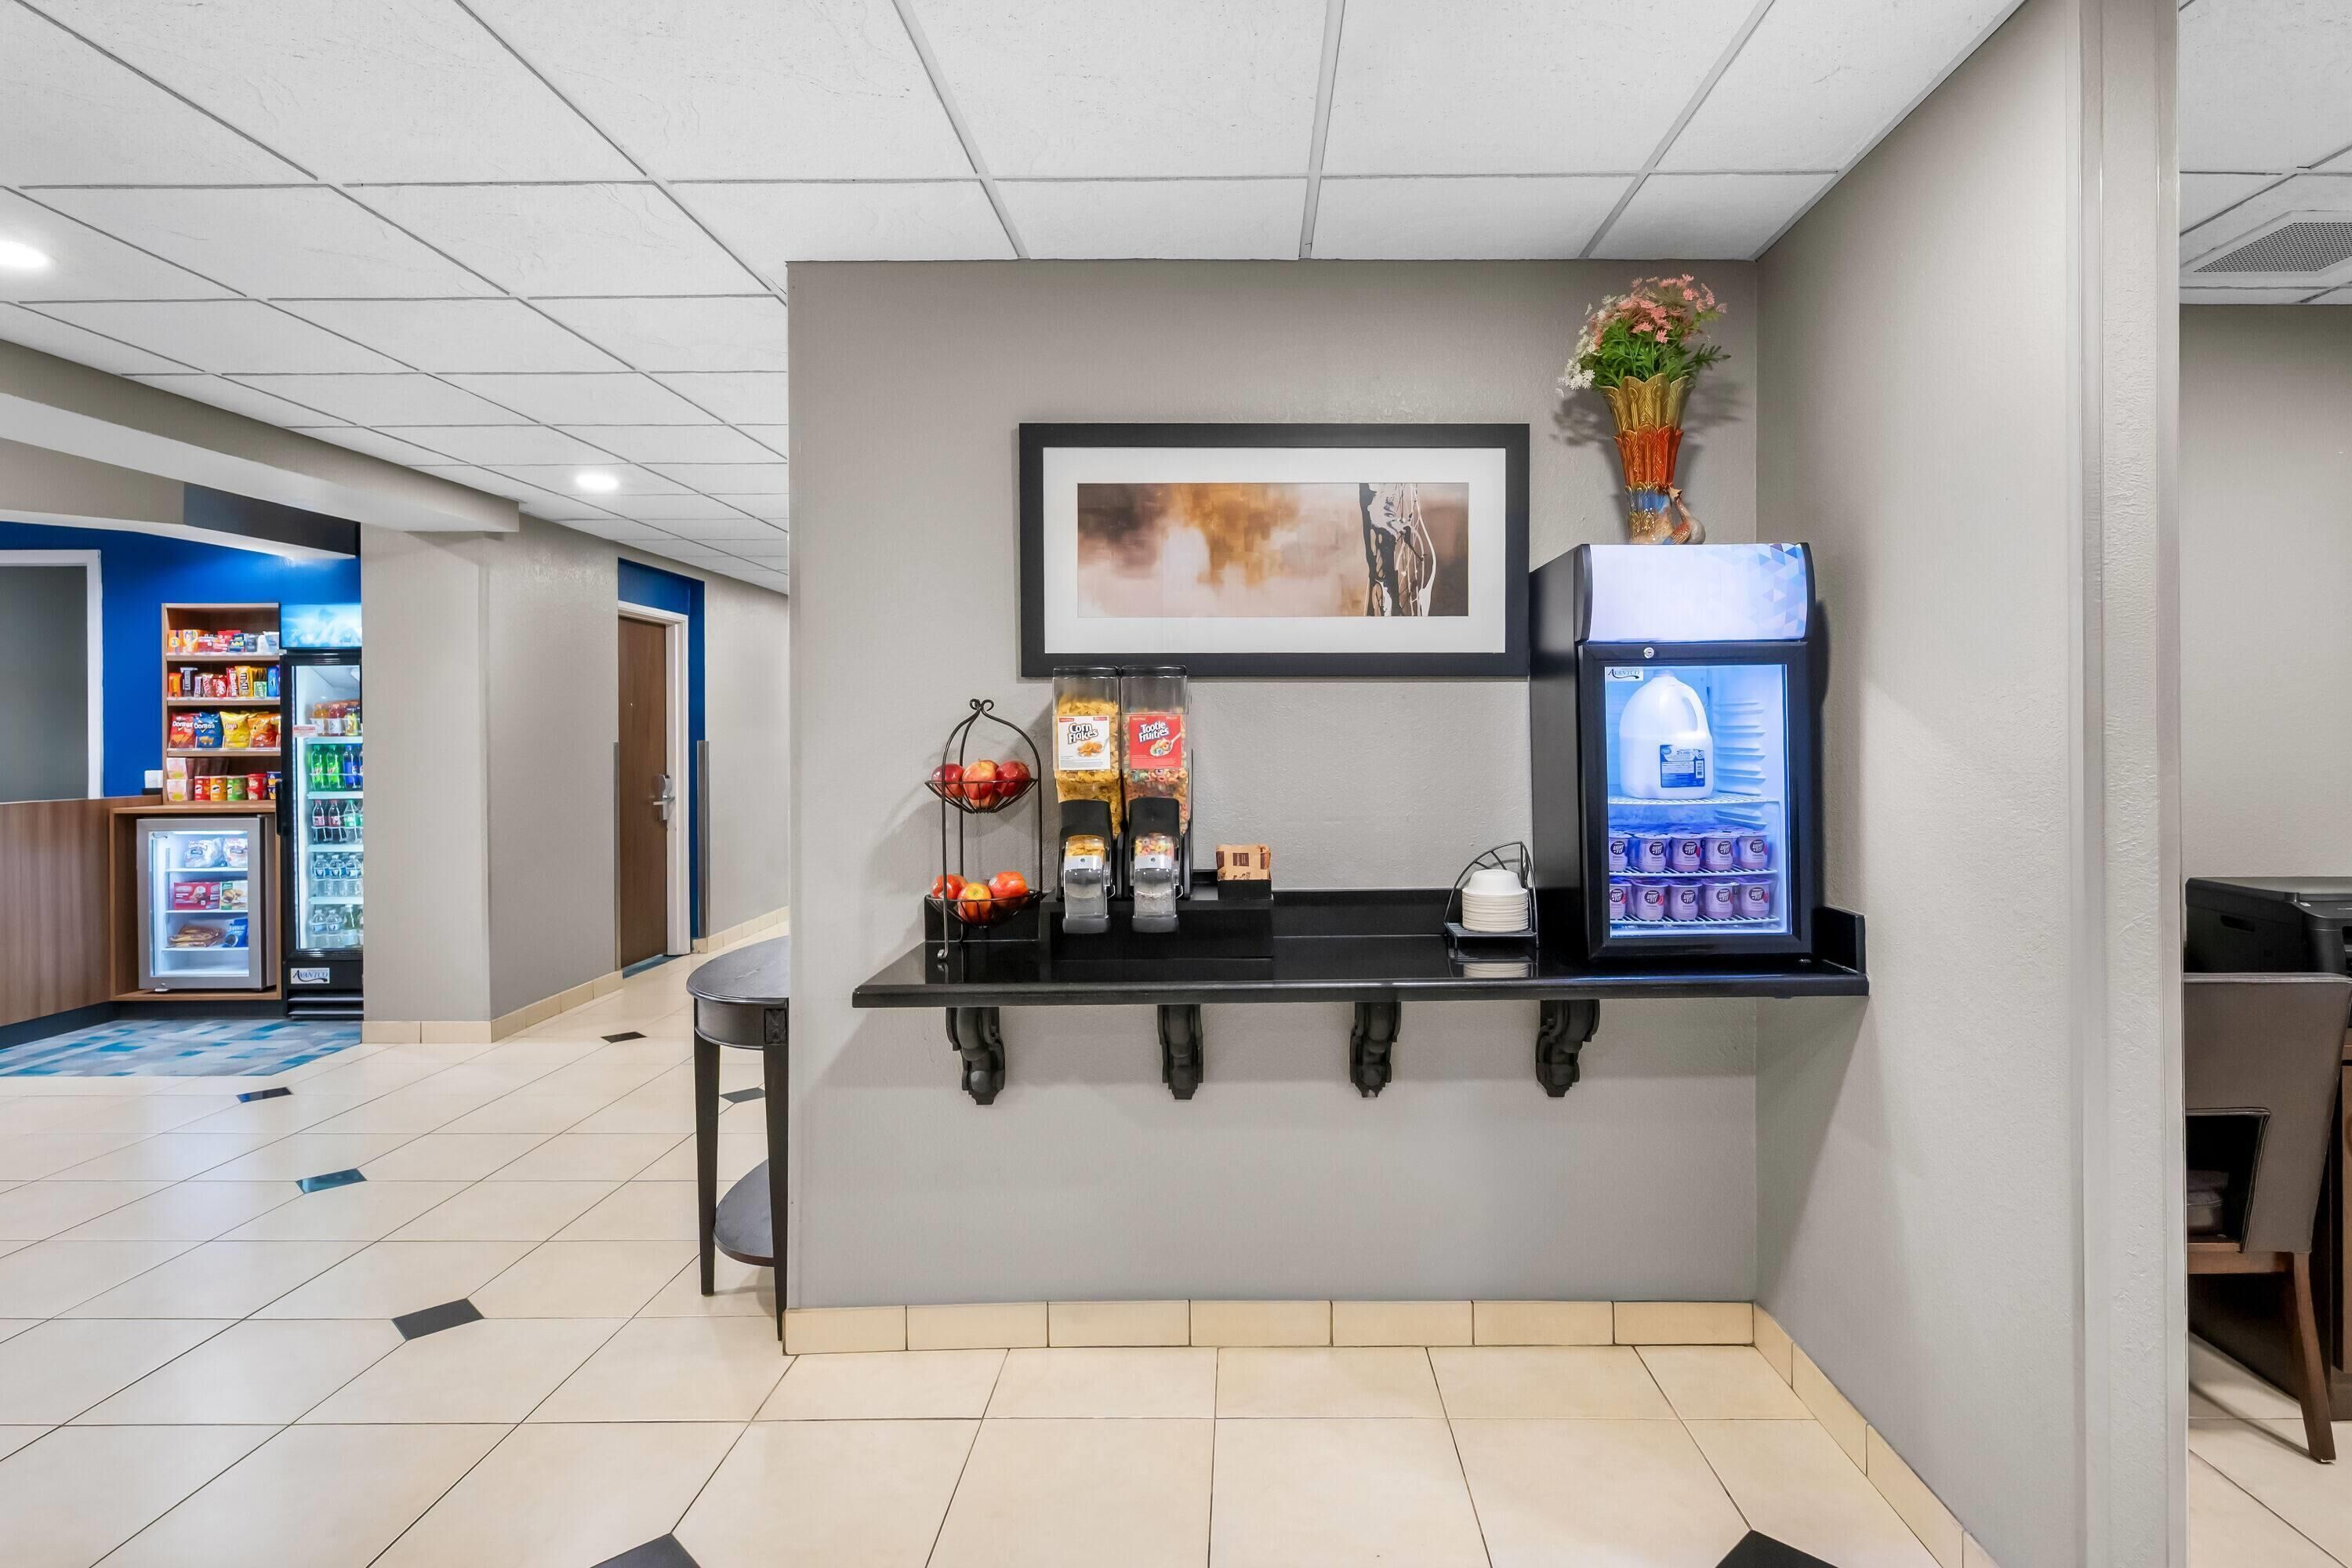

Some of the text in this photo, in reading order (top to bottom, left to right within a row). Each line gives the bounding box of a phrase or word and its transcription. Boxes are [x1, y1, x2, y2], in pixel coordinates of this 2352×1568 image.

[1069, 723, 1092, 734] Corn
[1140, 721, 1166, 733] Tootie
[1068, 729, 1098, 744] Flakes
[1138, 728, 1170, 742] Fruities
[292, 970, 328, 982] AVANTCO
